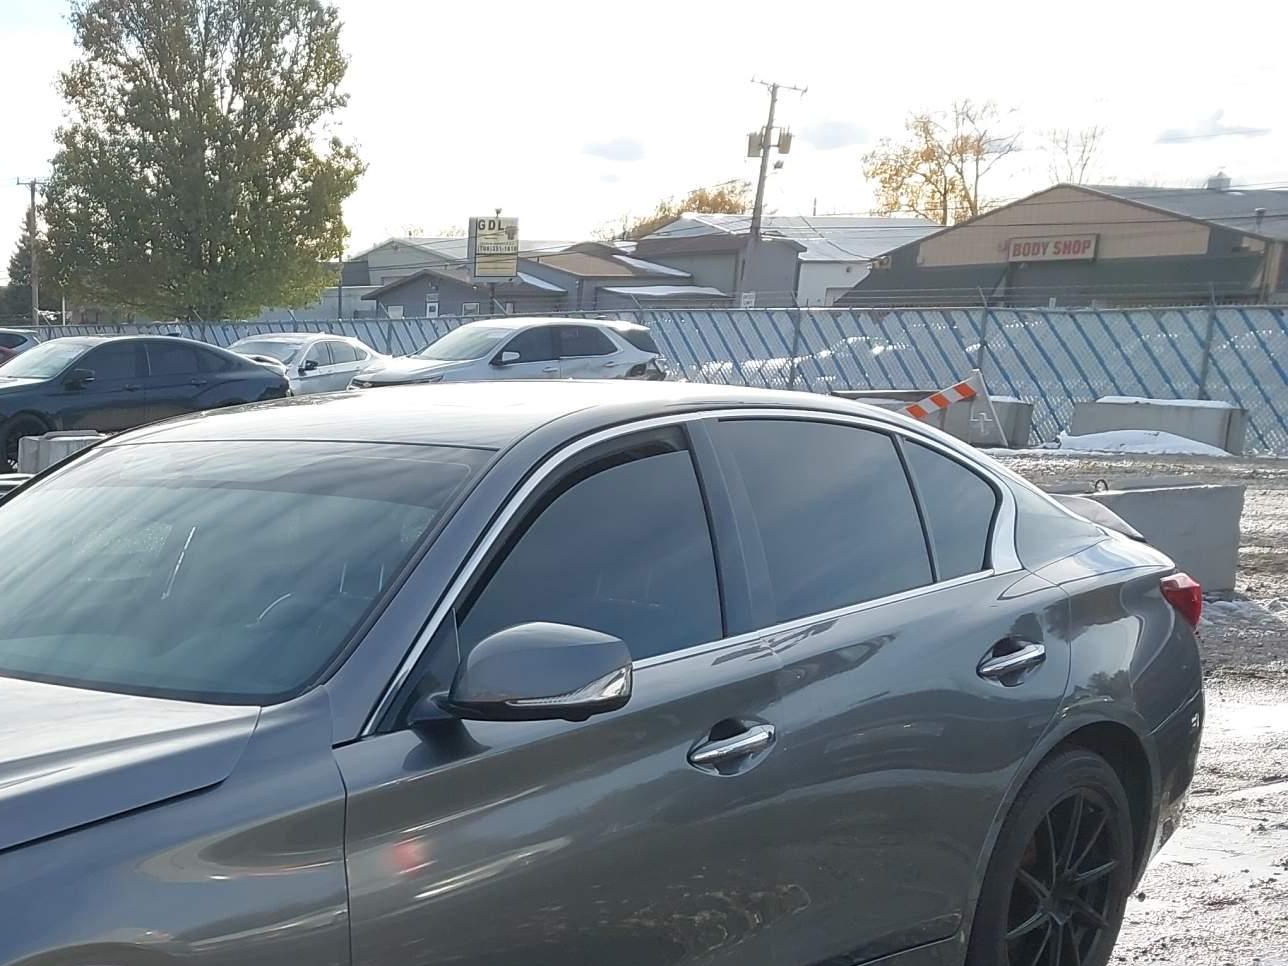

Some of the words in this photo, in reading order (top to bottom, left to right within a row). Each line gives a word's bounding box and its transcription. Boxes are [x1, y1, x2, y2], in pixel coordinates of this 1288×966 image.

[478, 219, 505, 231] GDL
[1013, 241, 1050, 257] BODY
[1052, 239, 1092, 255] SHOP
